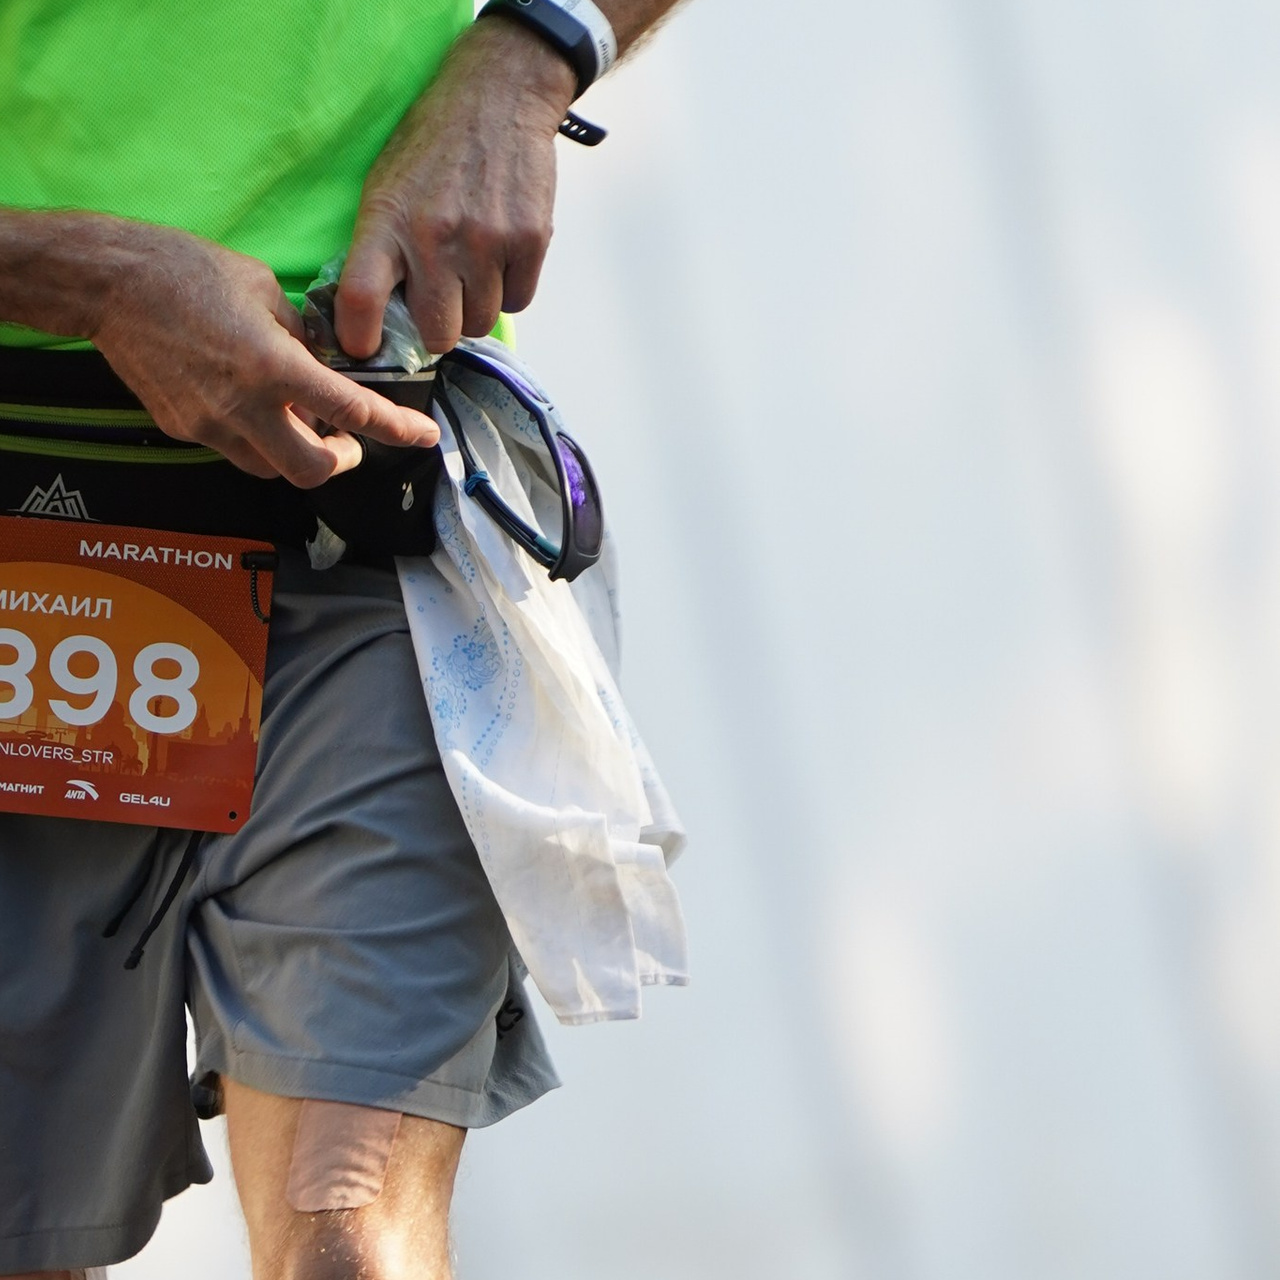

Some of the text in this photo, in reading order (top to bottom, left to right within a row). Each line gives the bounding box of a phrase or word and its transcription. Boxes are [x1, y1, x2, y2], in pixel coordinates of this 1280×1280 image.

[79, 540, 233, 570] MARATHON
[64, 789, 87, 800] ANTA
[119, 792, 171, 807] GEL4U
